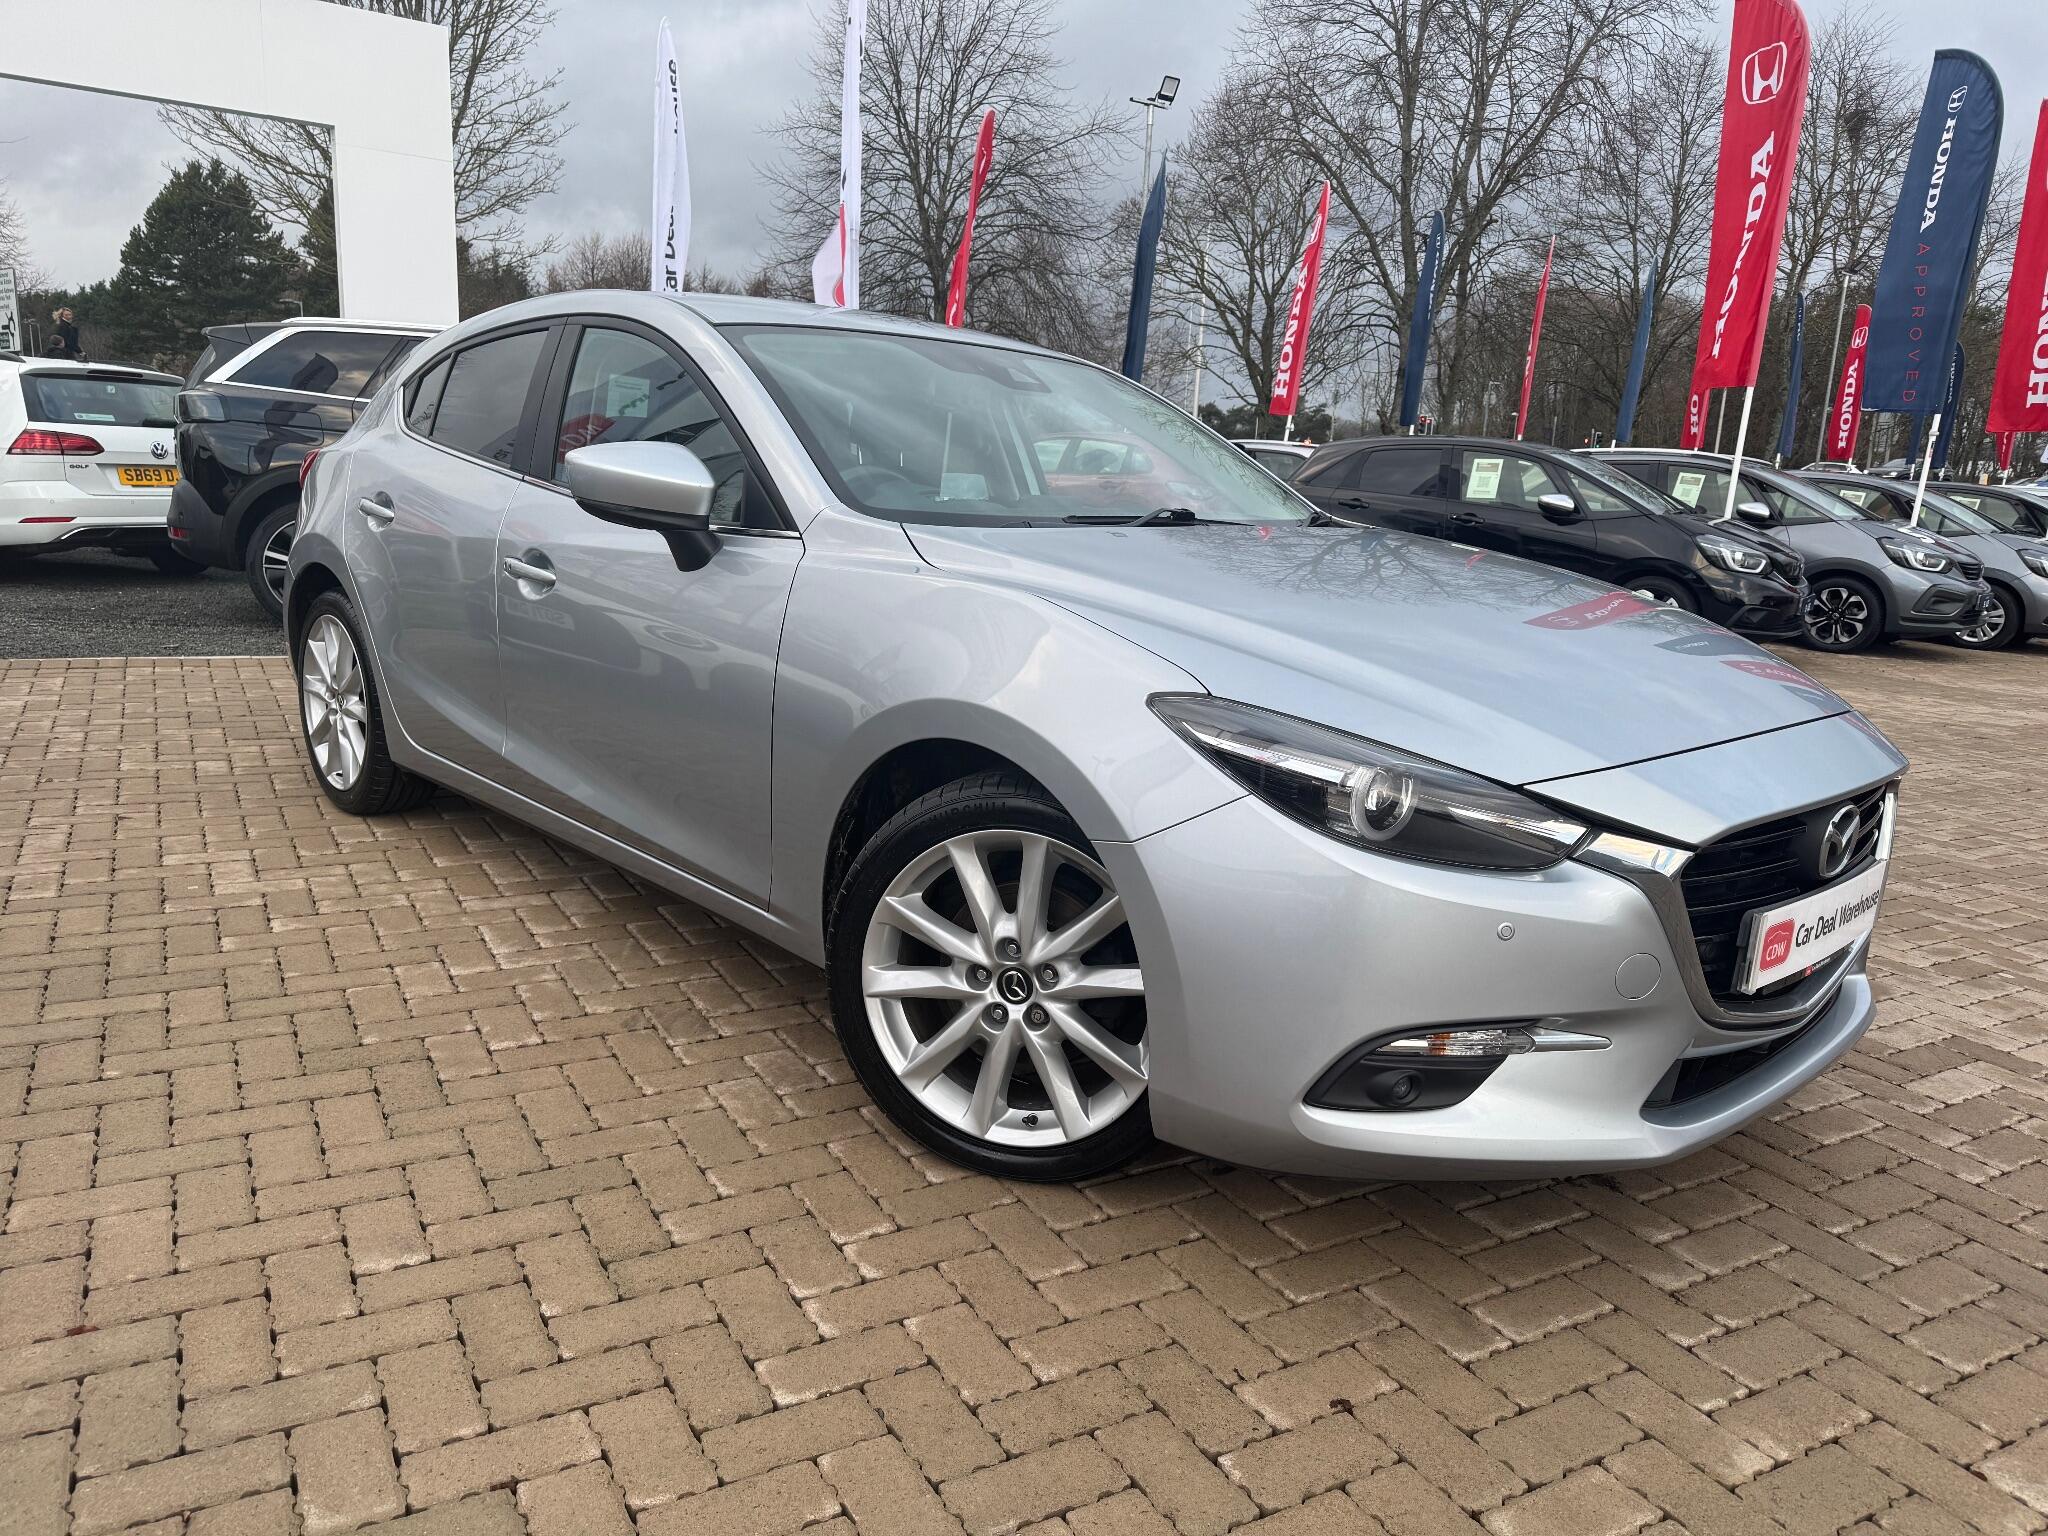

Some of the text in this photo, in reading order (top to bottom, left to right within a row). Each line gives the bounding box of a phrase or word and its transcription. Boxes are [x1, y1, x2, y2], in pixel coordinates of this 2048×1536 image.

[1712, 131, 1775, 359] HONDA
[1902, 115, 1958, 402] HONDA APPROVED
[663, 265, 678, 292] ar
[1690, 394, 1699, 436] HO
[1838, 358, 1859, 449] HONDA
[124, 469, 178, 482] SB69 D
[1795, 889, 1880, 948] Car Deal Warehouse
[1766, 941, 1787, 961] CDW
